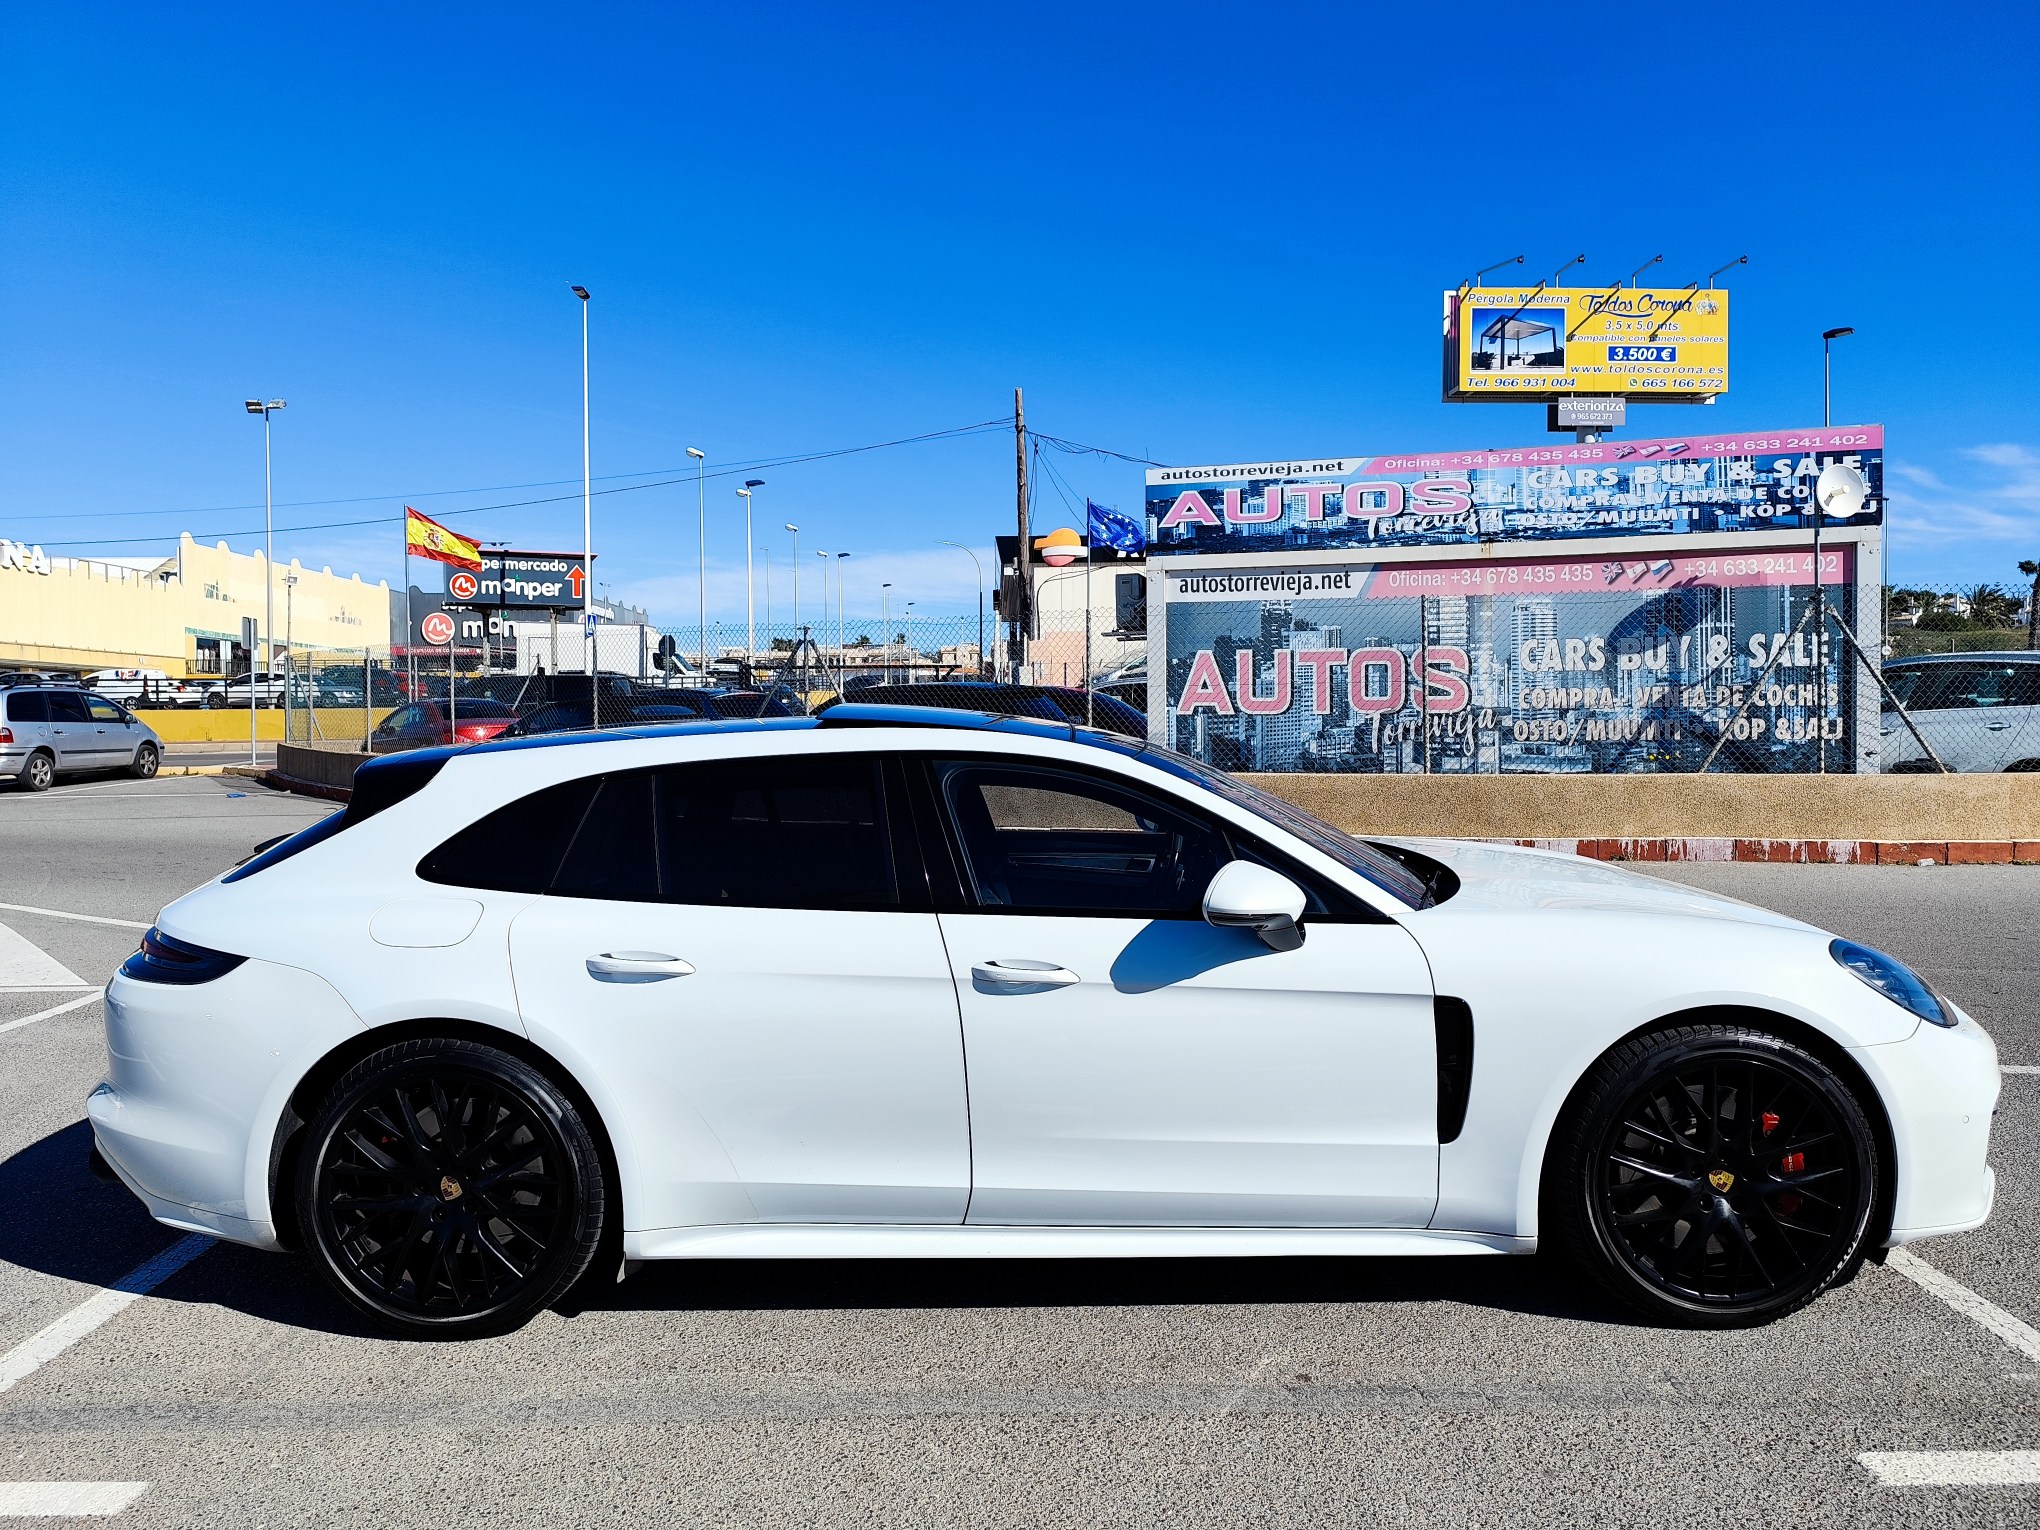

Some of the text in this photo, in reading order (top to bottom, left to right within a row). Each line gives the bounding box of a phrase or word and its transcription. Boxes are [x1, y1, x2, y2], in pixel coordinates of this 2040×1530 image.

[1467, 293, 1570, 305] Pérgola Moderna
[1579, 293, 1693, 316] Toldos Corona
[1605, 320, 1622, 331] 3,5
[1626, 322, 1632, 330] x
[1636, 320, 1653, 331] 5,0
[1689, 335, 1724, 343] solares
[1613, 347, 1673, 361] 3.500 €
[1570, 364, 1725, 375] www.toldoscorona.es
[1467, 378, 1577, 388] Tel. 966 931 004
[1642, 378, 1723, 388] 665 166 572
[1559, 400, 1625, 412] exterioriza
[1701, 434, 1868, 452] +34 633 241 402
[1384, 447, 1604, 469] Oficina: +34 678 435 435
[1160, 460, 1345, 481] autostorrevieja.net
[1527, 467, 1619, 489] CARS
[1634, 461, 1713, 485] BUY
[1729, 461, 1756, 480] &
[1159, 478, 1475, 529] AUTOS
[1525, 493, 1629, 510] COMPRA
[1738, 487, 1768, 501] DE
[1777, 482, 1872, 499] COS
[1740, 501, 1792, 519] KÖP
[1365, 508, 1504, 540] Torrevieja
[481, 558, 568, 573] permercado
[1388, 564, 1594, 588] Oficina: +34 678 435 435
[1684, 555, 1838, 577] +34 633 241 402
[480, 579, 563, 601] manper
[1179, 569, 1352, 596] autostorrevieja.net
[462, 616, 517, 639] man
[1520, 632, 1829, 671] CARS BUY & SALE
[1176, 646, 1472, 716] AUTOS
[1518, 687, 1615, 710] COMPRA
[1636, 685, 1708, 708] VENTA
[1716, 685, 1744, 707] DE
[1365, 705, 1498, 756] Torrvieja
